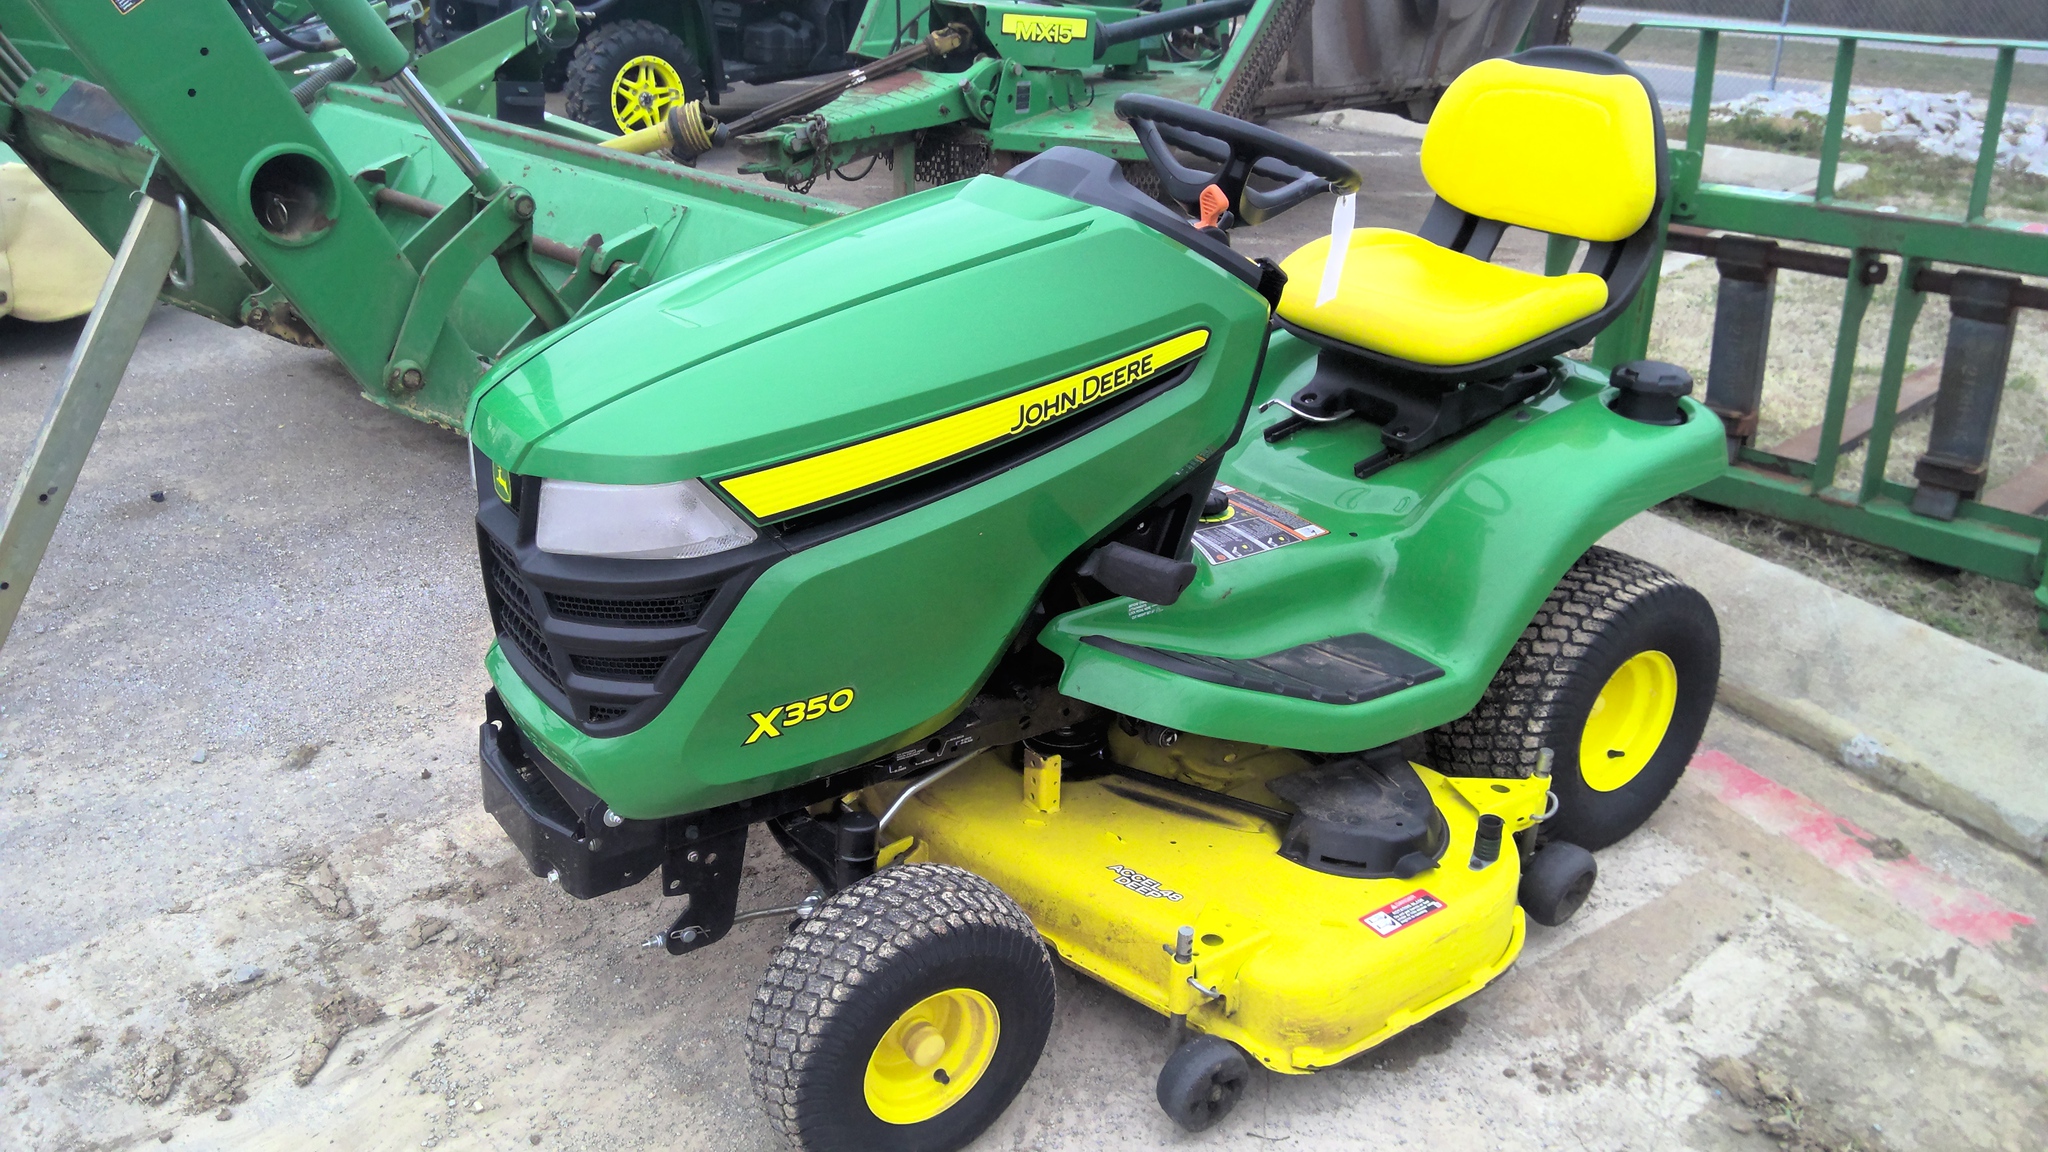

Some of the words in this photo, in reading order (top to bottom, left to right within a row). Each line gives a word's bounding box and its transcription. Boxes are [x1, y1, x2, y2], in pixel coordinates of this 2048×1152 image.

[1015, 21, 1072, 44] MX15
[1011, 387, 1078, 432] JOHN
[1083, 353, 1154, 402] DEERE
[741, 687, 855, 746] X350
[1106, 864, 1162, 892] ACCEL
[1161, 889, 1184, 902] 48
[1113, 876, 1163, 898] DEEP
